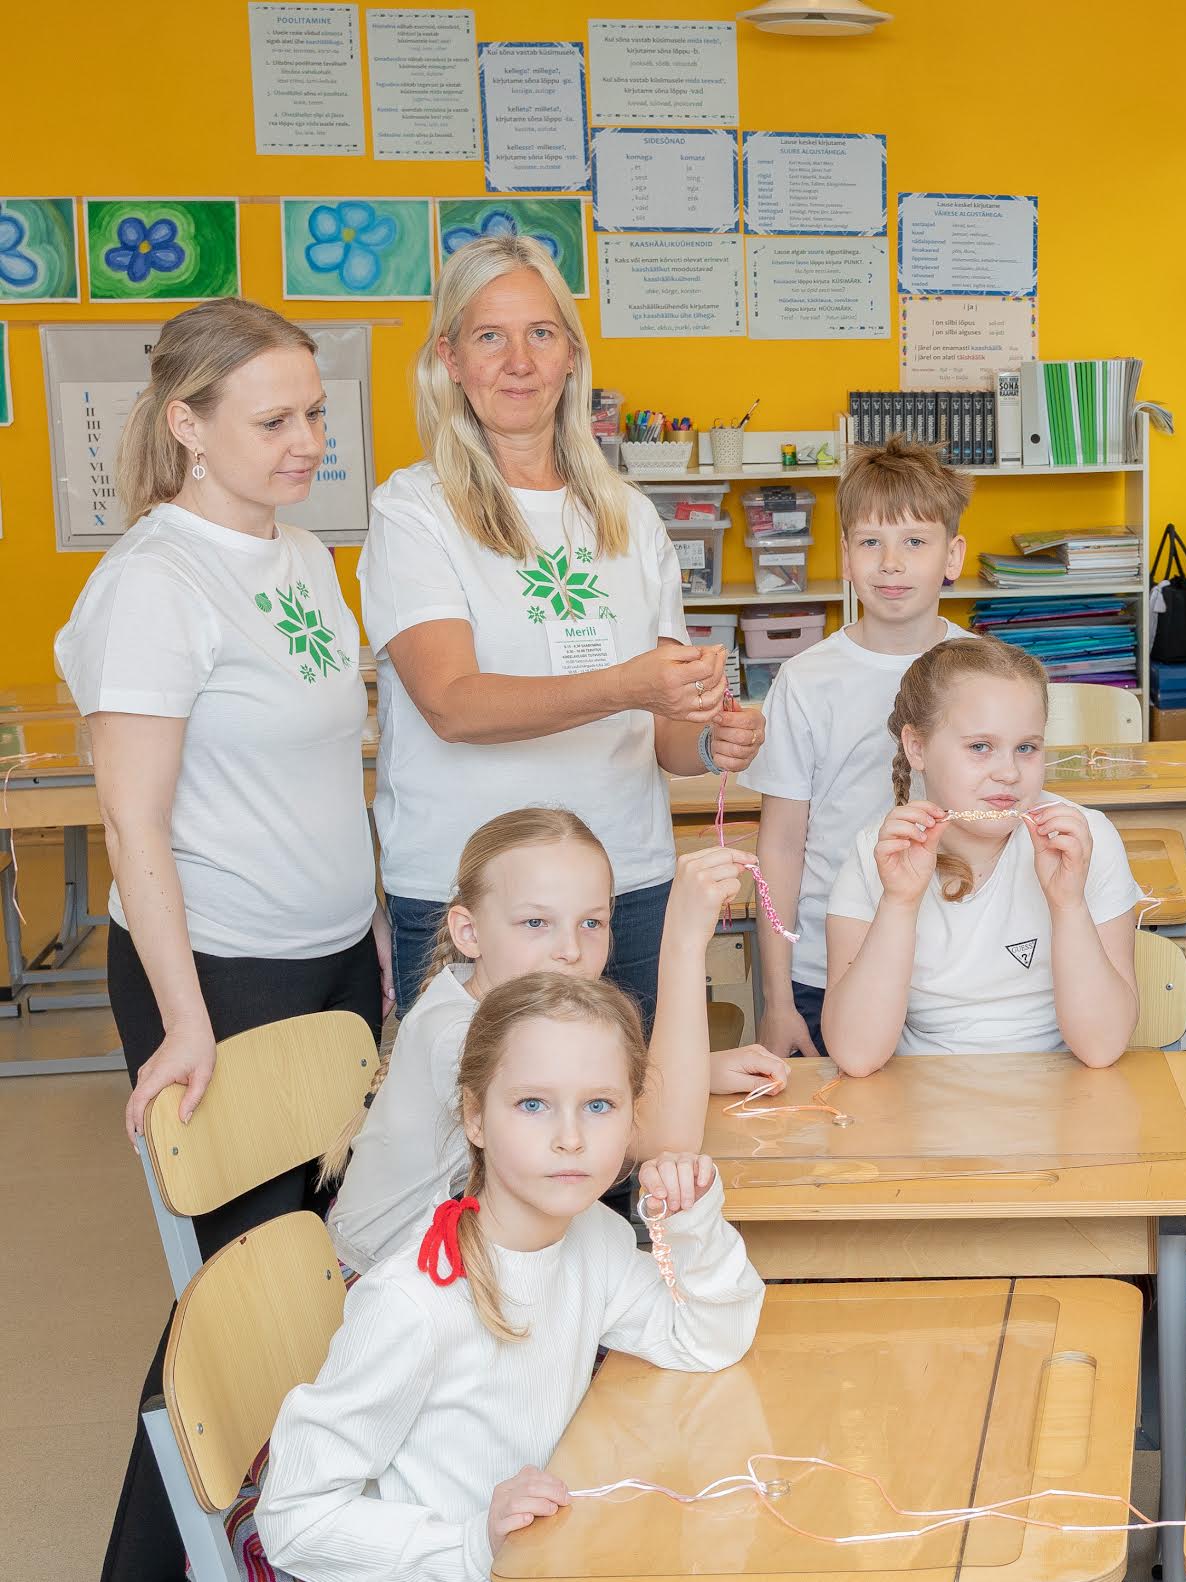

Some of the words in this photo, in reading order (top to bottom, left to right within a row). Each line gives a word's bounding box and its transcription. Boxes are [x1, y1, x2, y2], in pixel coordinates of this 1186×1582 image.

[277, 17, 332, 25] POOLITAMINE
[492, 78, 525, 86] kirjutame
[643, 137, 686, 145] SIDESÕNAD
[629, 240, 713, 248] KAASHÄÄLIKUÜHENDID
[689, 303, 719, 311] kirjutame
[87, 407, 95, 417] II
[88, 420, 102, 430] III
[88, 433, 102, 442] IV
[89, 446, 101, 457] V
[90, 462, 104, 472] VI
[91, 475, 110, 484] VII
[316, 470, 347, 481] 1000
[93, 488, 117, 497] VIII
[93, 501, 108, 511] IX
[95, 514, 106, 526] X
[565, 626, 597, 637] Merili
[1011, 941, 1034, 953] GUESS
